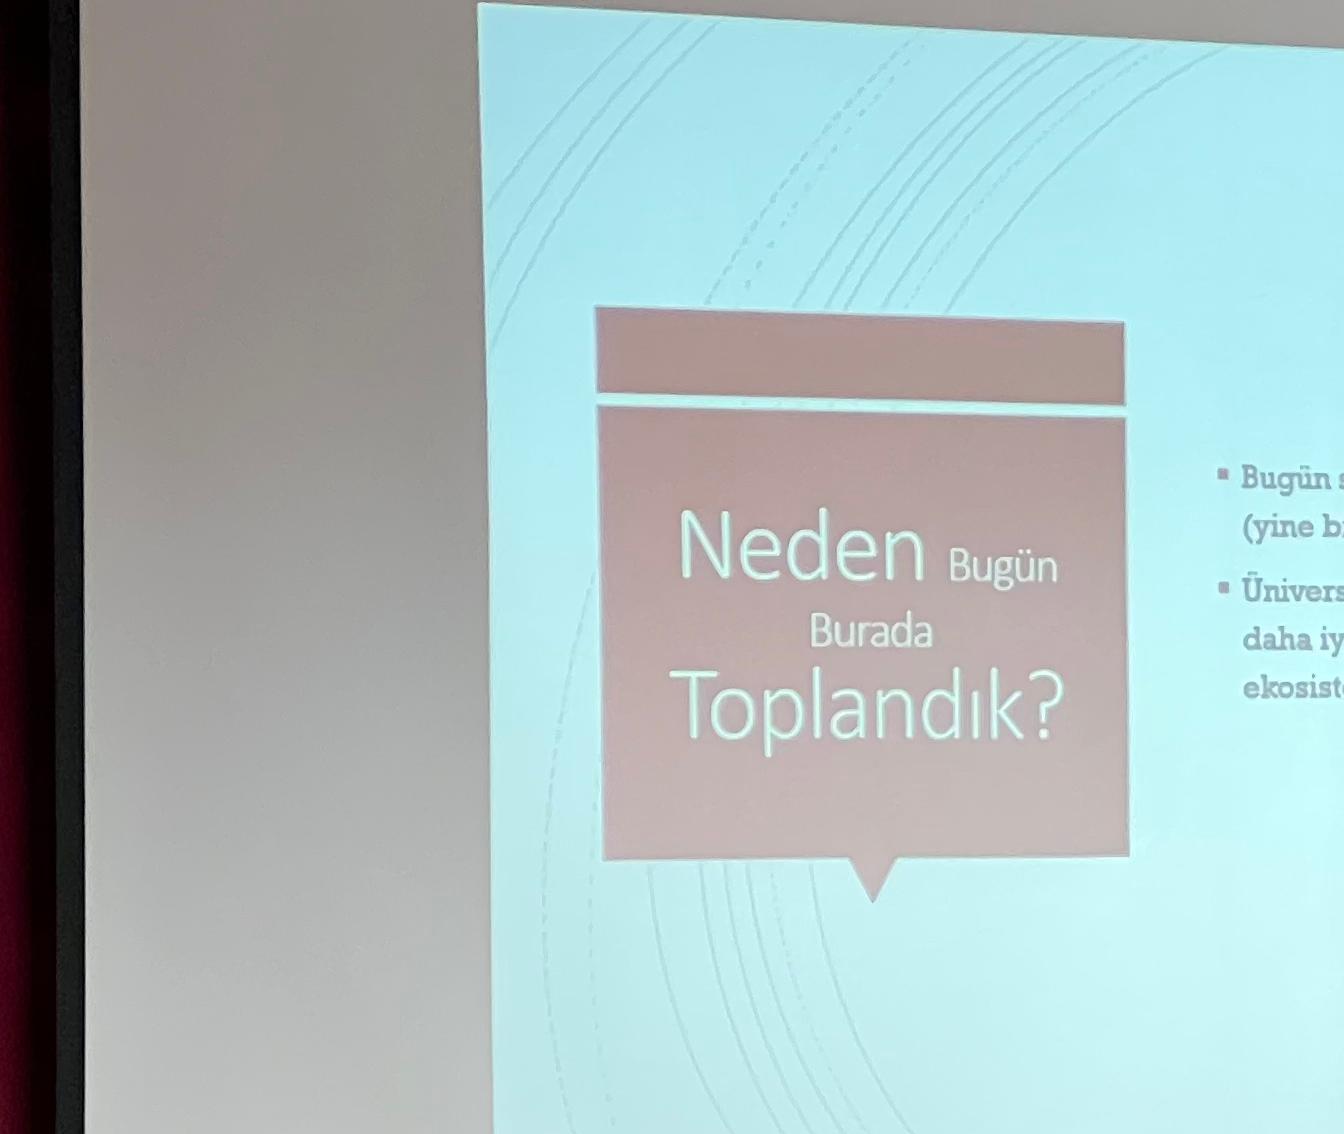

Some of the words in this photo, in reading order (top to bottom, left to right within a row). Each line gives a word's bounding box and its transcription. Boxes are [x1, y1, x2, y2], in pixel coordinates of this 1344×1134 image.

[1240, 464, 1332, 497] Bugün
[1243, 513, 1314, 545] (yine
[680, 507, 925, 582] Neden
[948, 547, 1059, 591] Bugün
[810, 610, 933, 648] Burada
[1242, 626, 1313, 651] daha
[669, 665, 1066, 759] Toplandık?
